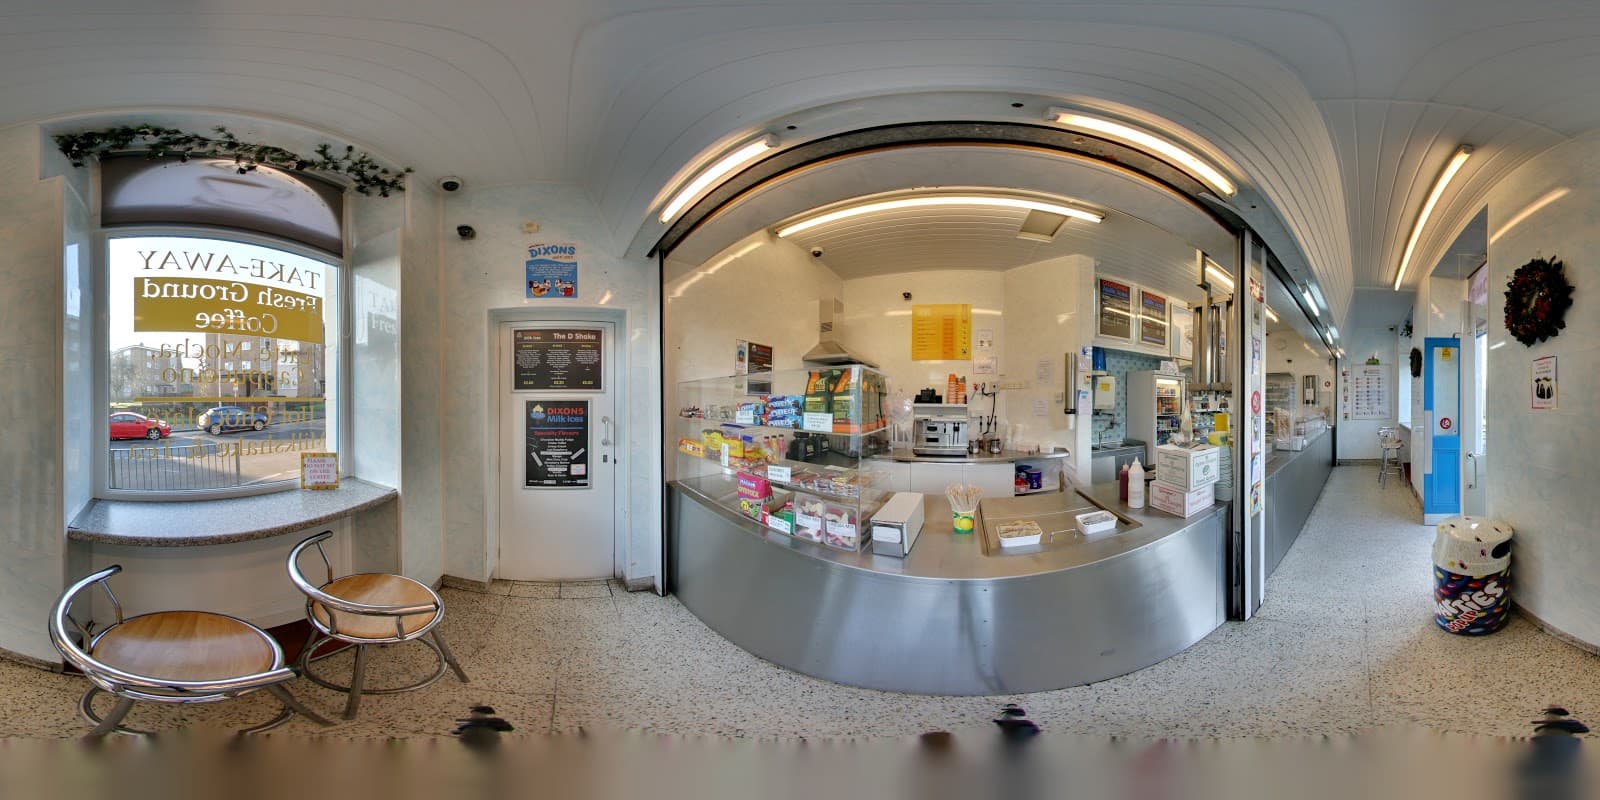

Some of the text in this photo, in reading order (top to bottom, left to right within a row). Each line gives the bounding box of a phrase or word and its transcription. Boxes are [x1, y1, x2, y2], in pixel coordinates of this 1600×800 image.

[528, 245, 576, 257] DIXONS
[547, 407, 585, 416] DIXONS
[547, 415, 566, 423] Milk
